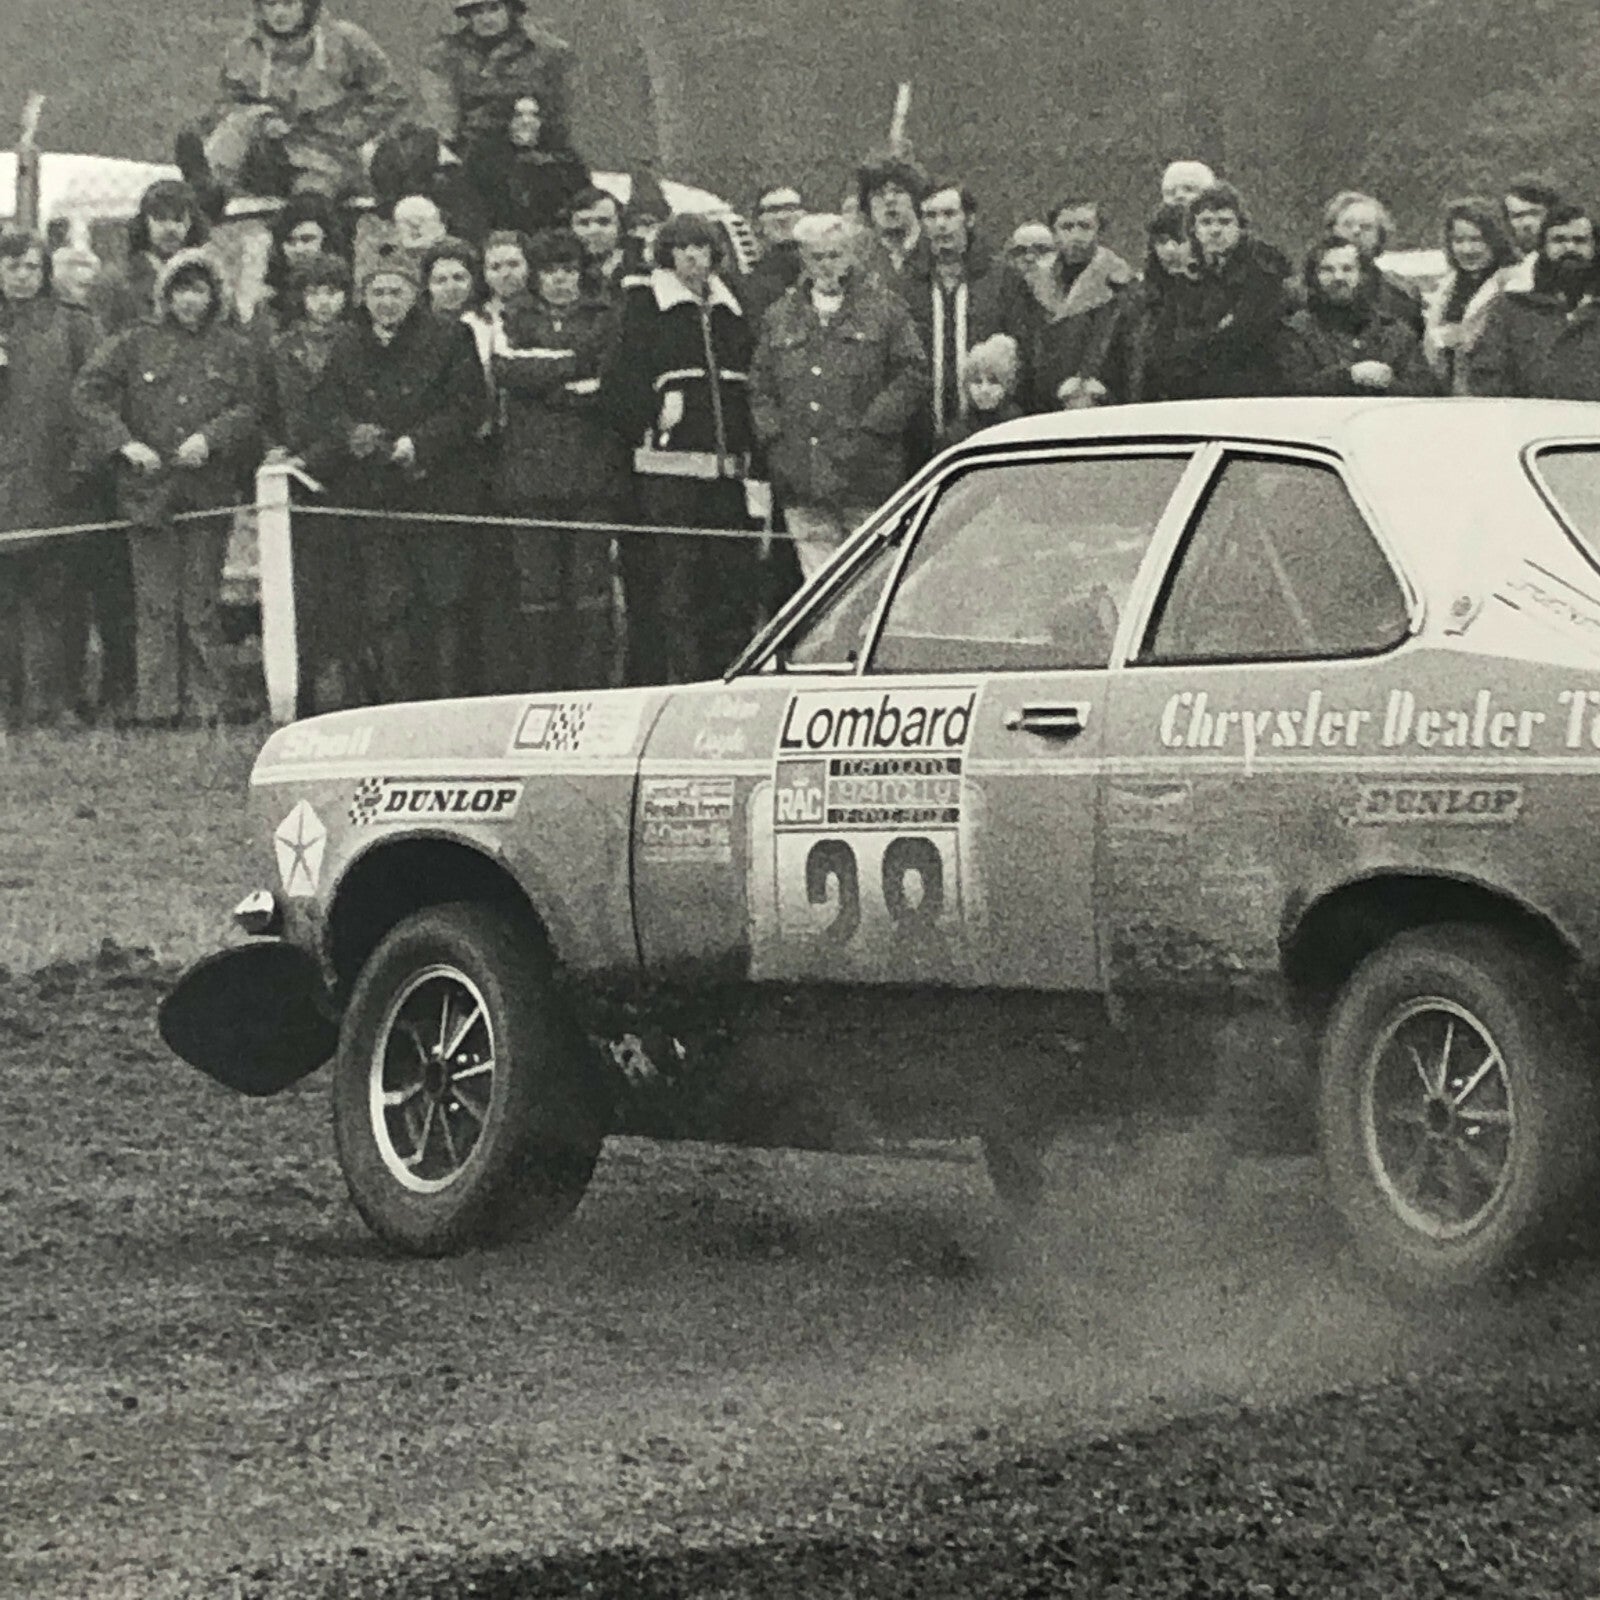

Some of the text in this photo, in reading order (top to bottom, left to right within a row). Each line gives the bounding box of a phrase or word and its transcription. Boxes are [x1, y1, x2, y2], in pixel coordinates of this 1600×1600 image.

[779, 692, 977, 749] Lombard
[1159, 689, 1370, 776] Chrysler
[1382, 689, 1545, 748] Dealer
[383, 787, 518, 813] DUNLOP
[776, 787, 822, 822] RAC
